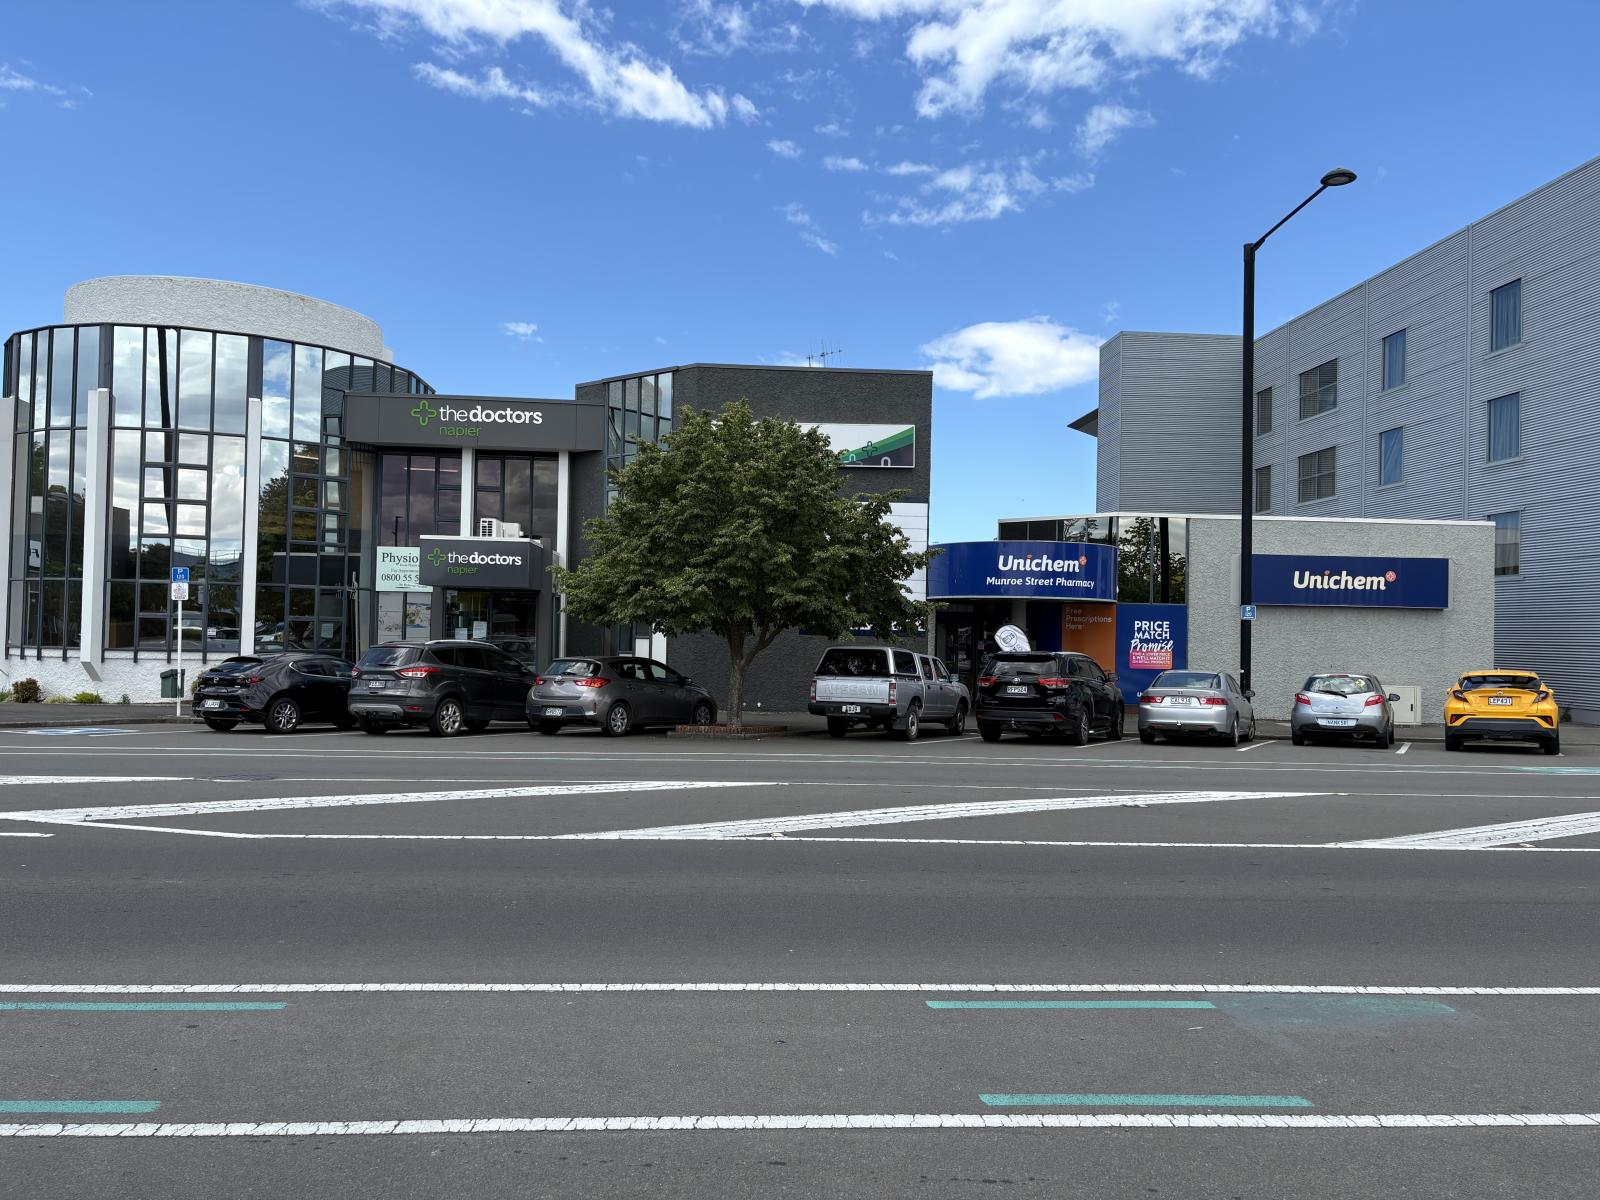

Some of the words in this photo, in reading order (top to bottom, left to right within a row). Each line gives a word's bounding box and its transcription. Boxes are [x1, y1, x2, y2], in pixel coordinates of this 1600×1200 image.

[439, 424, 481, 438] napier
[998, 553, 1080, 573] Unichem
[447, 565, 478, 575] napier
[381, 573, 401, 582] 0800
[402, 574, 412, 582] 55
[986, 577, 1023, 585] Munroe
[1025, 577, 1053, 586] Street
[1055, 578, 1095, 590] Pharmacy
[1293, 569, 1386, 591] Unichem
[1065, 615, 1113, 623] Prescriptions
[1134, 620, 1170, 632] PRICE
[1134, 631, 1170, 640] MATCH
[1130, 639, 1174, 653] Promise
